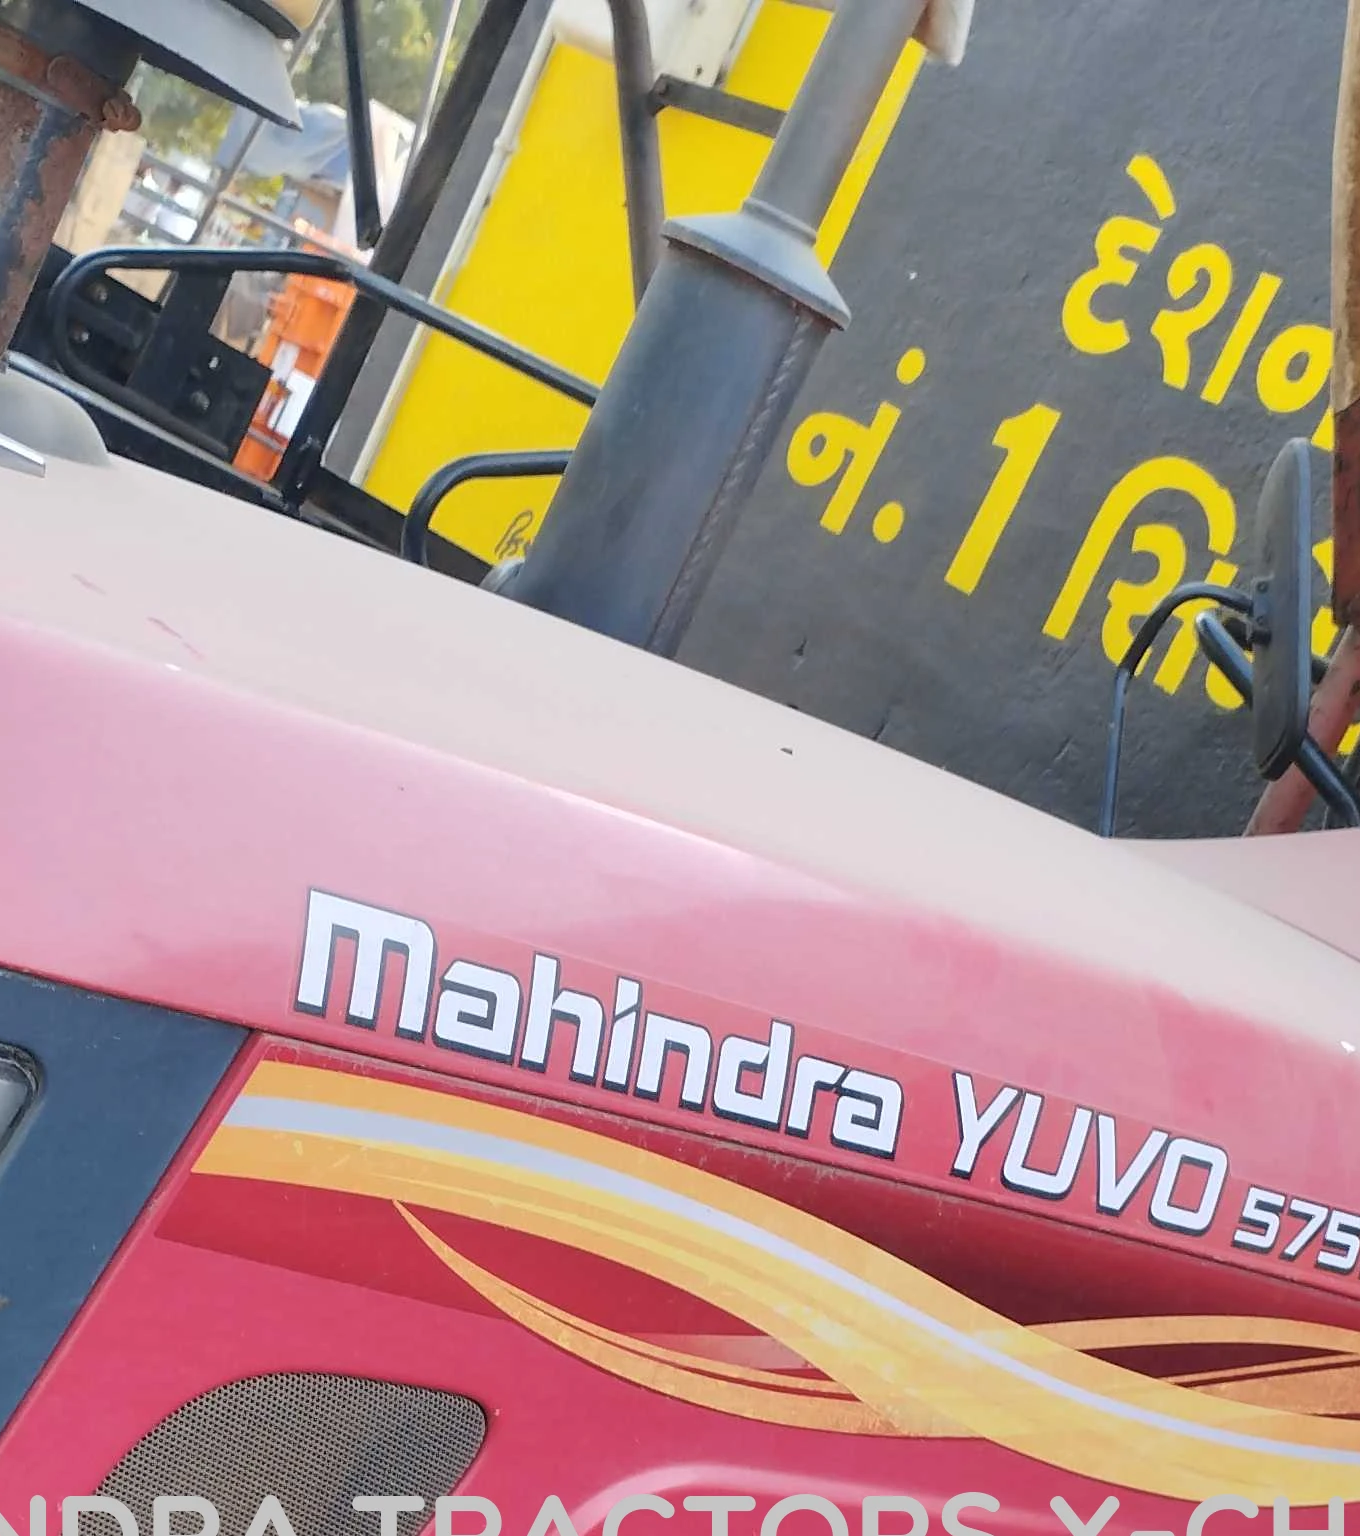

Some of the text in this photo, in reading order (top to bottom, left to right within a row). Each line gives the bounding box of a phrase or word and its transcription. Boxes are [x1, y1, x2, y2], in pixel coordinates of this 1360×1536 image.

[944, 403, 1061, 596] 1
[294, 887, 904, 1161] Mahindra
[948, 1070, 1229, 1237] YUVO
